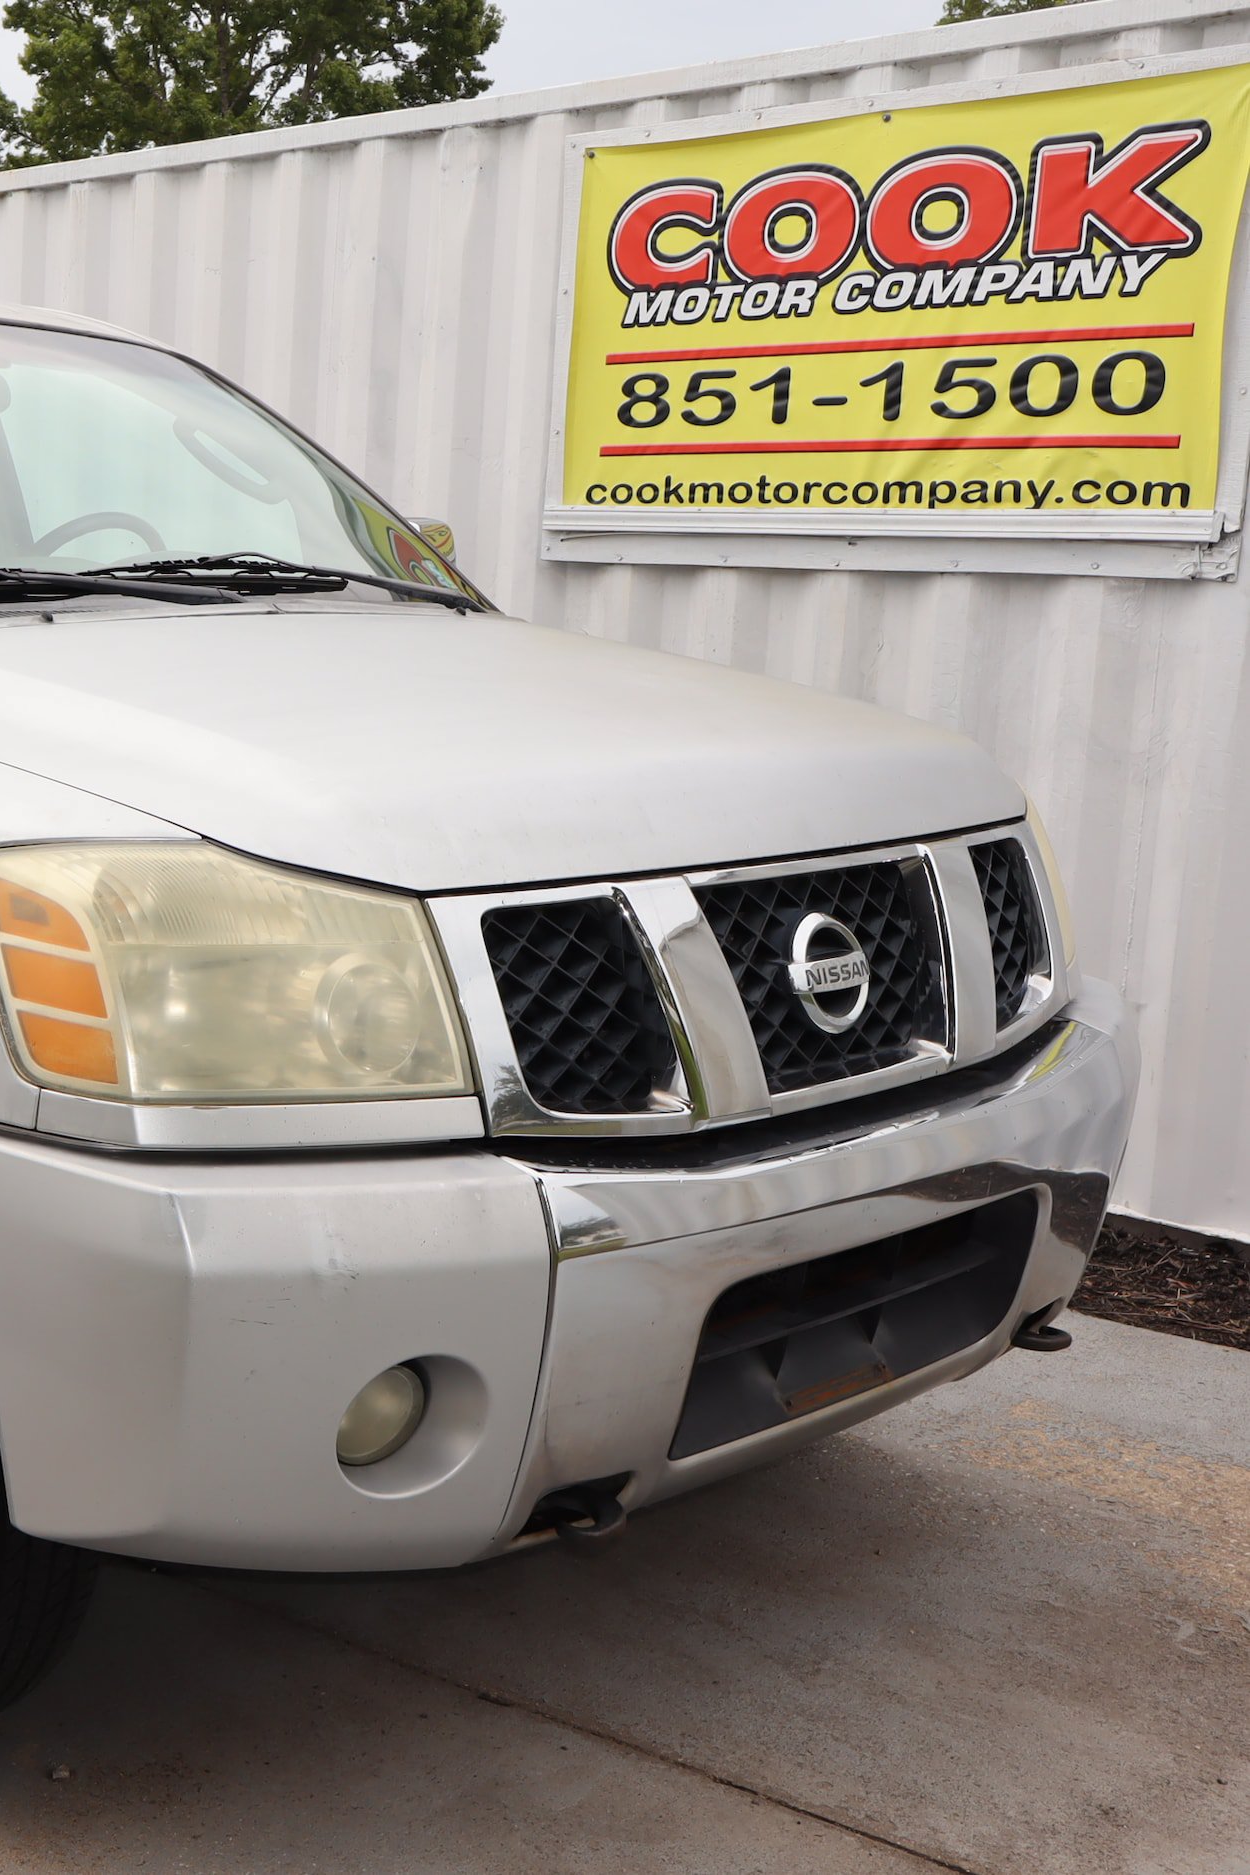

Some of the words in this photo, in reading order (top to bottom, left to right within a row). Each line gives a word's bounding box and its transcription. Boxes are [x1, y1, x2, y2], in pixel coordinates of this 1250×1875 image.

[610, 121, 1209, 292] COOK
[622, 279, 816, 326] MOTOR
[833, 251, 1167, 311] COMPANY
[617, 350, 1166, 428] 851-1500
[585, 474, 1191, 510] cookmotorcompany.com
[805, 959, 870, 987] NISSAN
